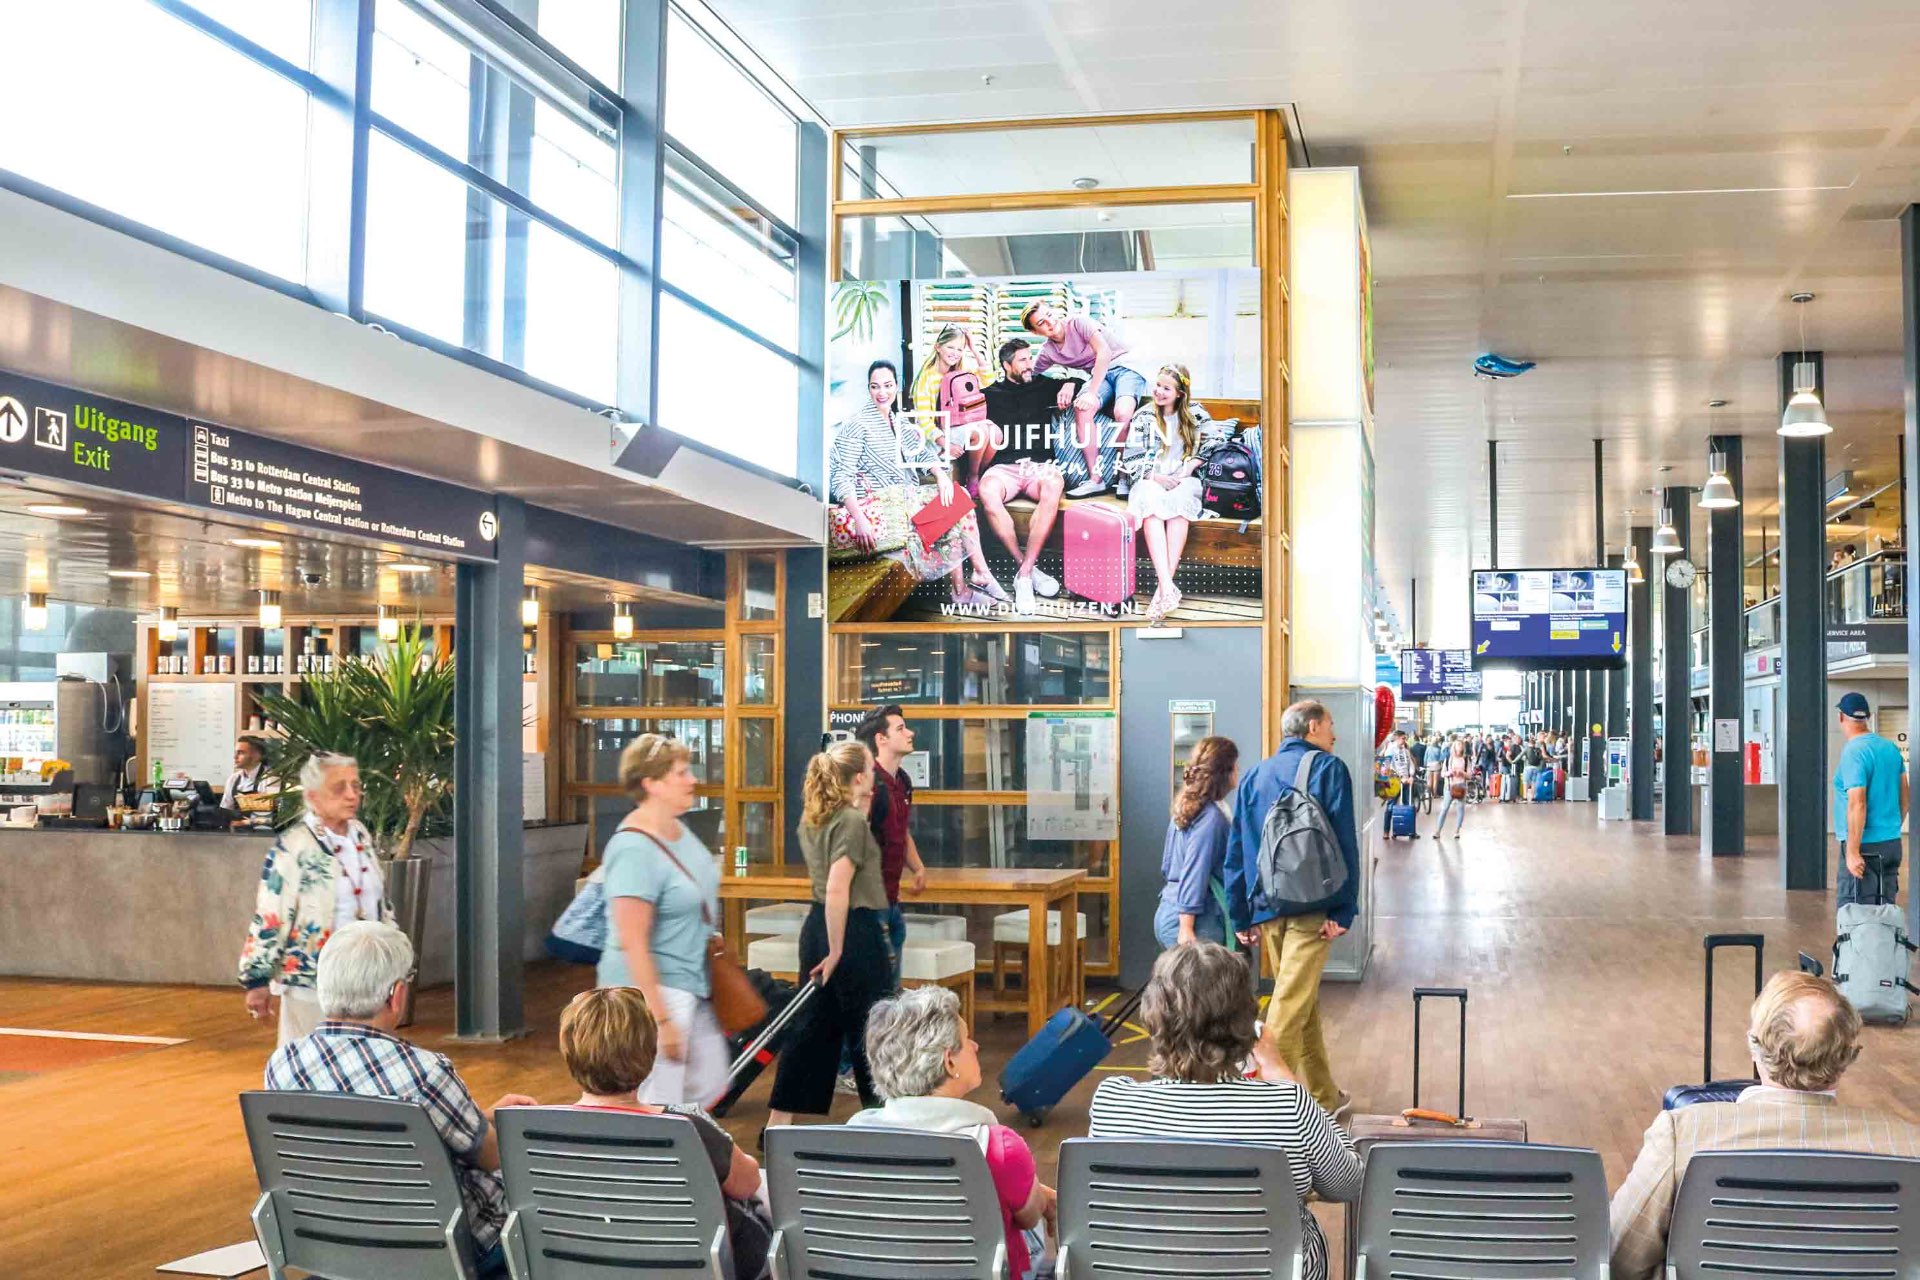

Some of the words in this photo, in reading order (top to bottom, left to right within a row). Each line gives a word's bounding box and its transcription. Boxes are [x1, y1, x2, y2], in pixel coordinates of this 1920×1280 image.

[75, 404, 158, 451] Uitgang
[210, 433, 229, 448] Taxi
[964, 421, 1172, 451] DUIFHUIZEN
[74, 441, 110, 471] Exit
[1113, 449, 1193, 482] koffs
[210, 451, 228, 466] Bus
[230, 459, 243, 471] 33
[245, 461, 255, 472] to
[257, 462, 301, 482] Rotterdam
[302, 472, 332, 489] Central
[333, 479, 360, 495] Station
[210, 470, 228, 484] Bus
[230, 476, 243, 489] 33
[245, 478, 255, 490] to
[257, 480, 283, 495] Metro
[284, 487, 313, 502] station
[314, 492, 362, 511] Meijersplein
[226, 492, 252, 507] Metro
[254, 498, 265, 509] to
[267, 499, 283, 513] The
[285, 503, 312, 519] Hague
[313, 509, 342, 525] Central
[343, 515, 369, 529] station
[371, 522, 380, 531] or
[381, 522, 416, 539] Rotterdam
[417, 529, 441, 543] Central
[442, 534, 465, 548] Station
[940, 602, 1144, 616] WWW.DUHUIZEN.NL
